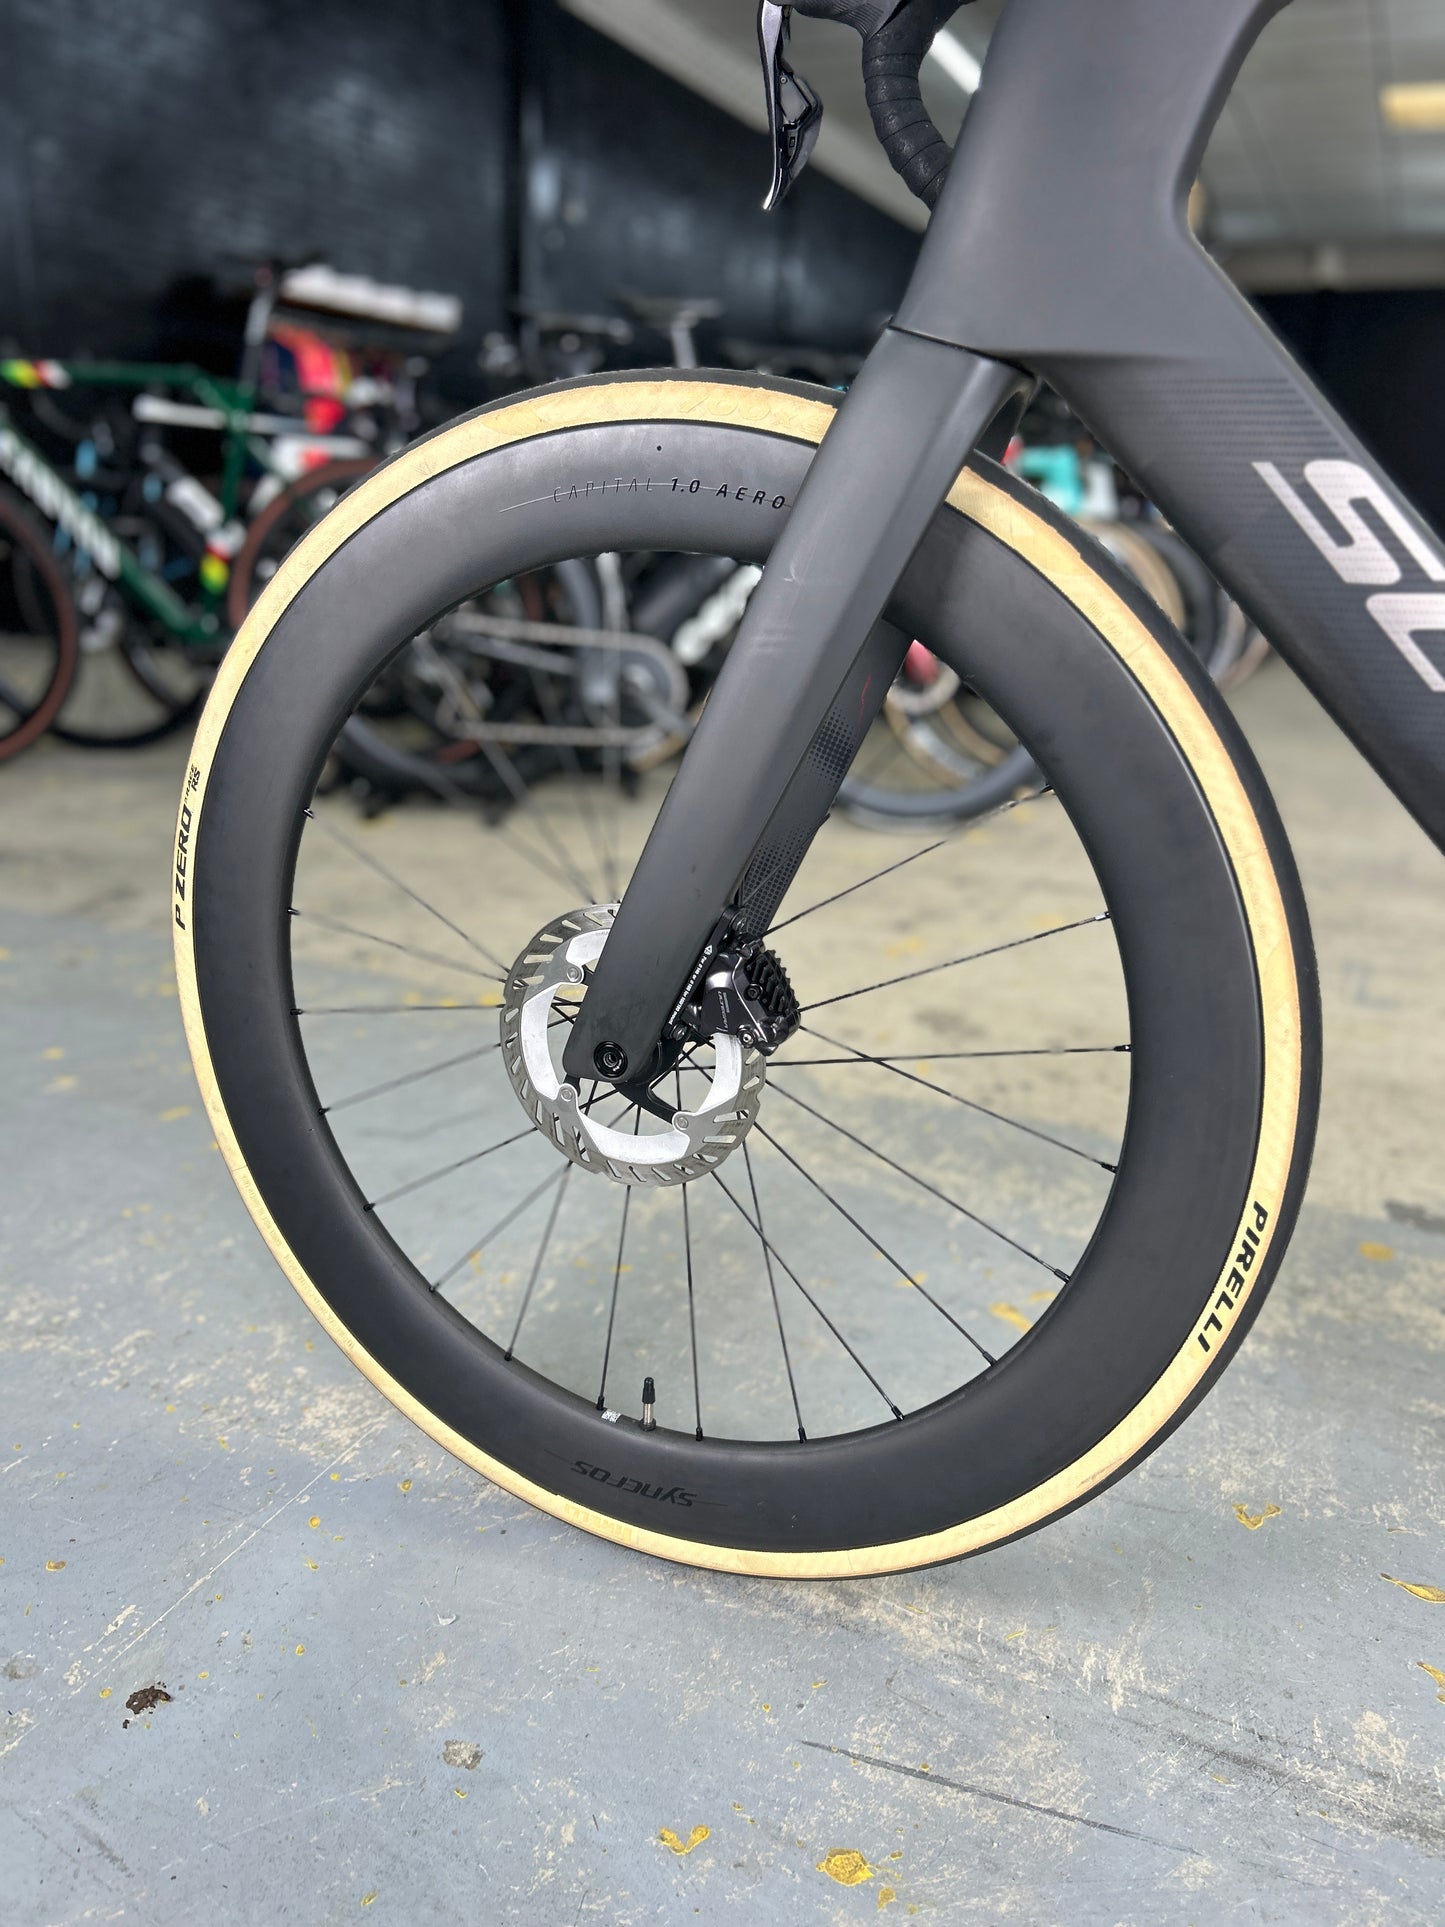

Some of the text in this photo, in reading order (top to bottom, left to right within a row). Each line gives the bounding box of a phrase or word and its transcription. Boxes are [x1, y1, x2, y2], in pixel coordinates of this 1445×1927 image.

[553, 477, 786, 511] CAPITAL 1.0 AERO
[191, 769, 201, 792] RS
[175, 804, 193, 901] ZERO
[175, 903, 186, 930] P
[1197, 1200, 1269, 1353] PIRELLI
